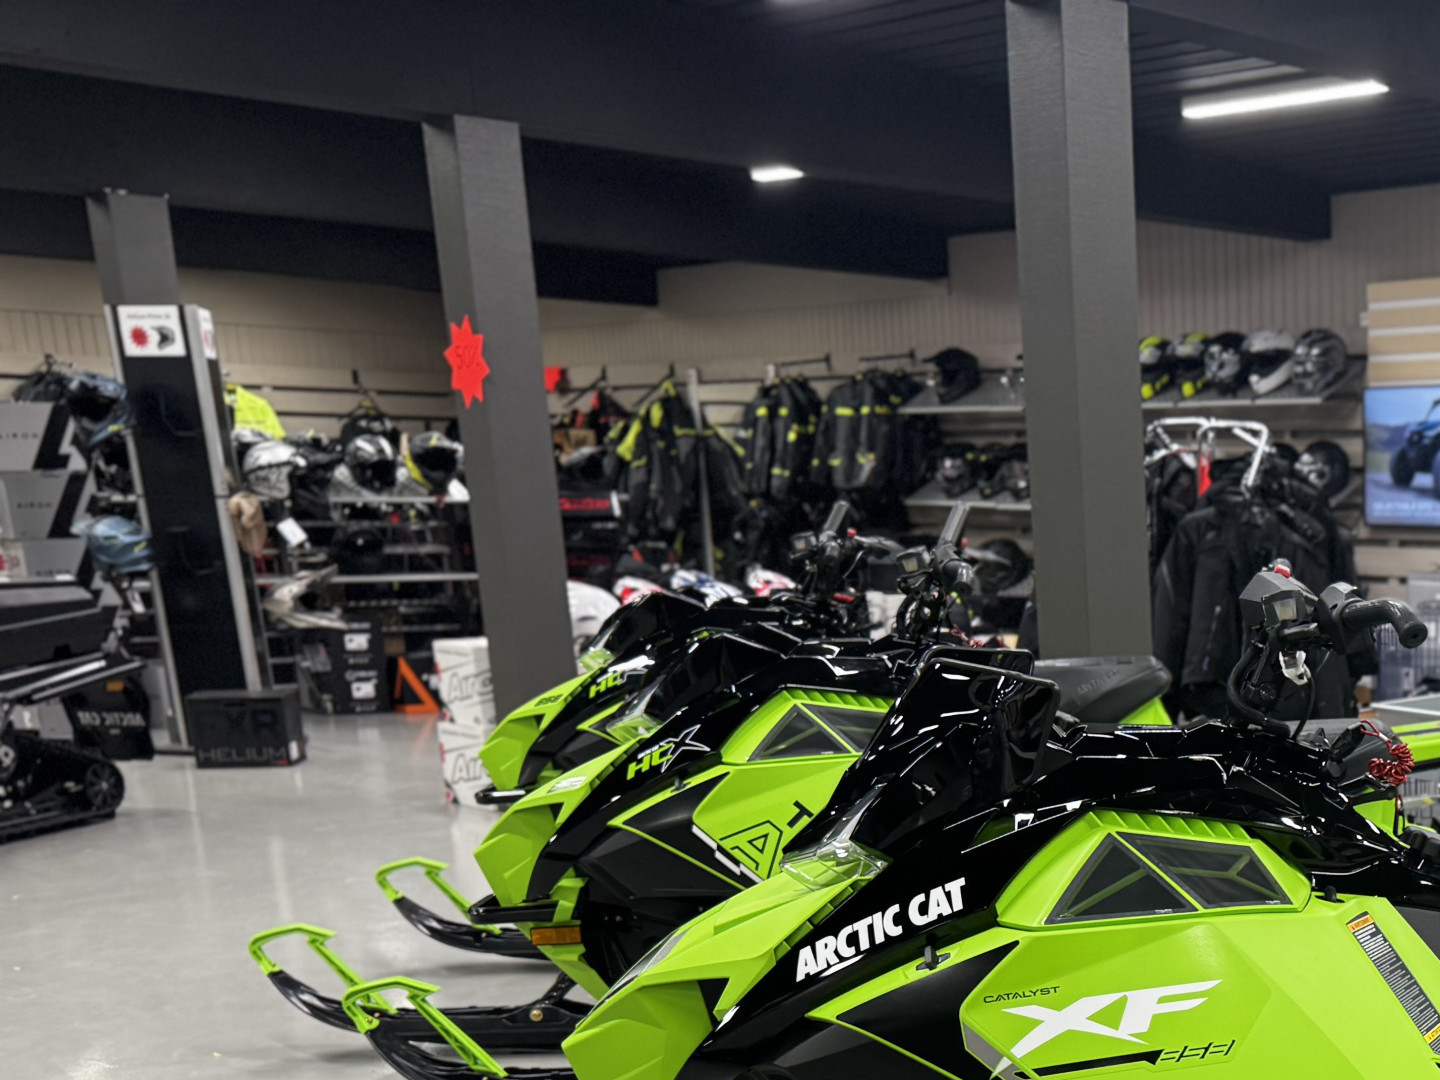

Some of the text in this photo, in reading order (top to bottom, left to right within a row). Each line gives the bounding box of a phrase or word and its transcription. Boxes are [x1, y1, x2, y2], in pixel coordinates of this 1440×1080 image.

[199, 747, 287, 762] HELIUM
[627, 724, 711, 781] HCX
[796, 877, 966, 983] ARCTIC CAT
[983, 985, 1061, 1004] CATALYST
[989, 979, 1223, 1080] XF
